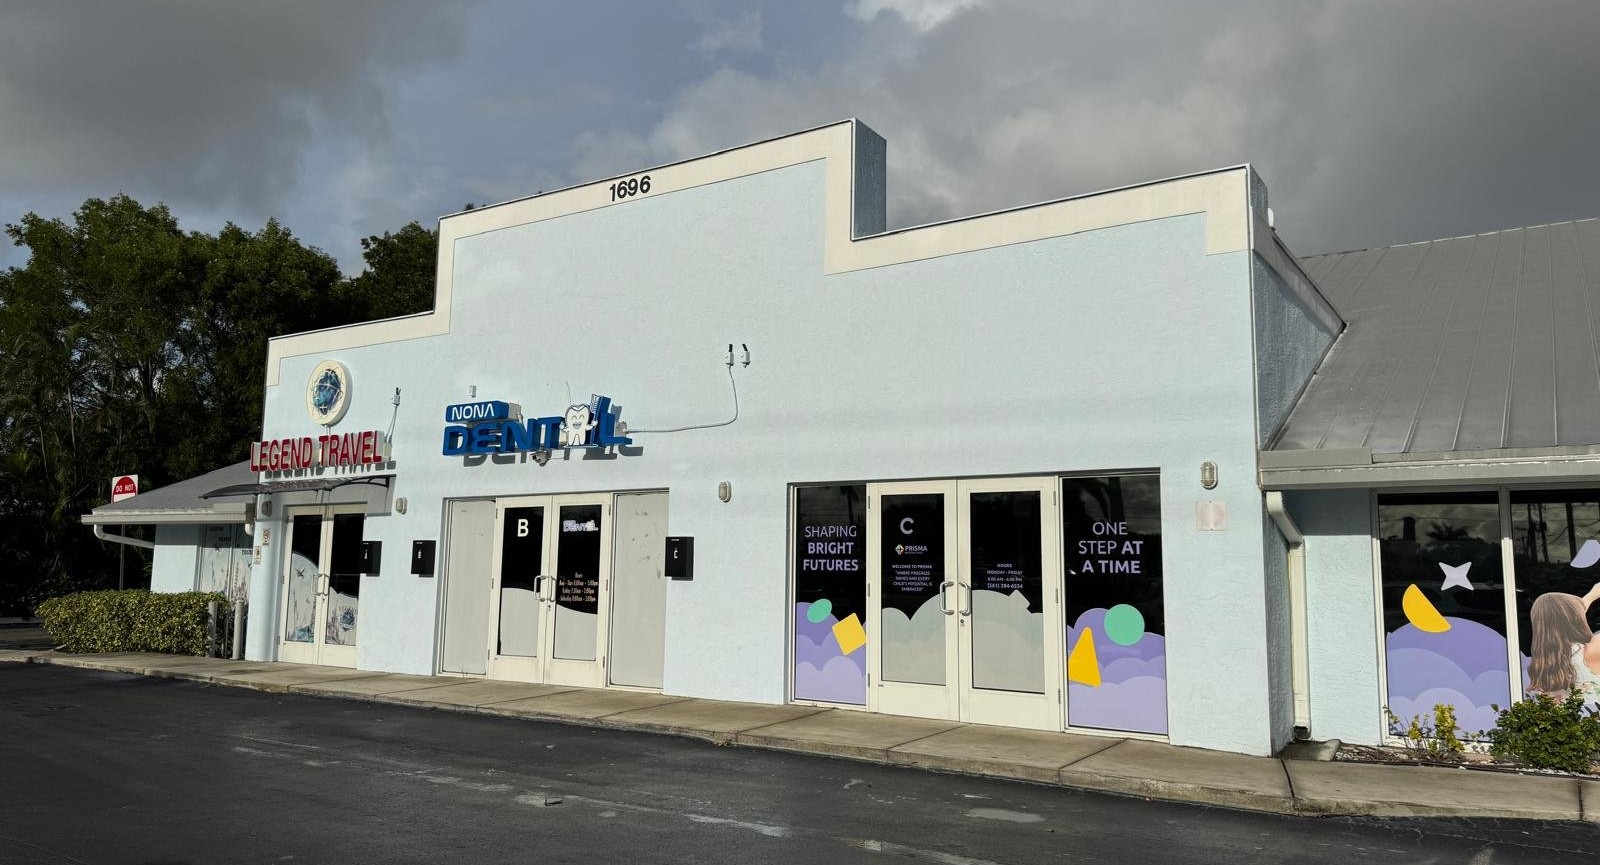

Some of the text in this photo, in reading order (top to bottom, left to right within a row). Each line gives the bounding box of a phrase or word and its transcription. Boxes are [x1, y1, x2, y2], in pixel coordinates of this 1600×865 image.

[610, 175, 651, 202] 1696
[451, 403, 494, 420] NONA
[443, 394, 632, 456] DENTL
[250, 430, 382, 472] LEGEND TRAVEL
[517, 518, 529, 537] B
[804, 525, 857, 538] SHAPING
[900, 517, 914, 535] C
[1092, 521, 1128, 536] ONE
[808, 542, 854, 554] BRIGHT
[1078, 540, 1144, 555] STEP AT
[803, 558, 859, 571] FUTURES
[1081, 559, 1141, 574] A TIME
